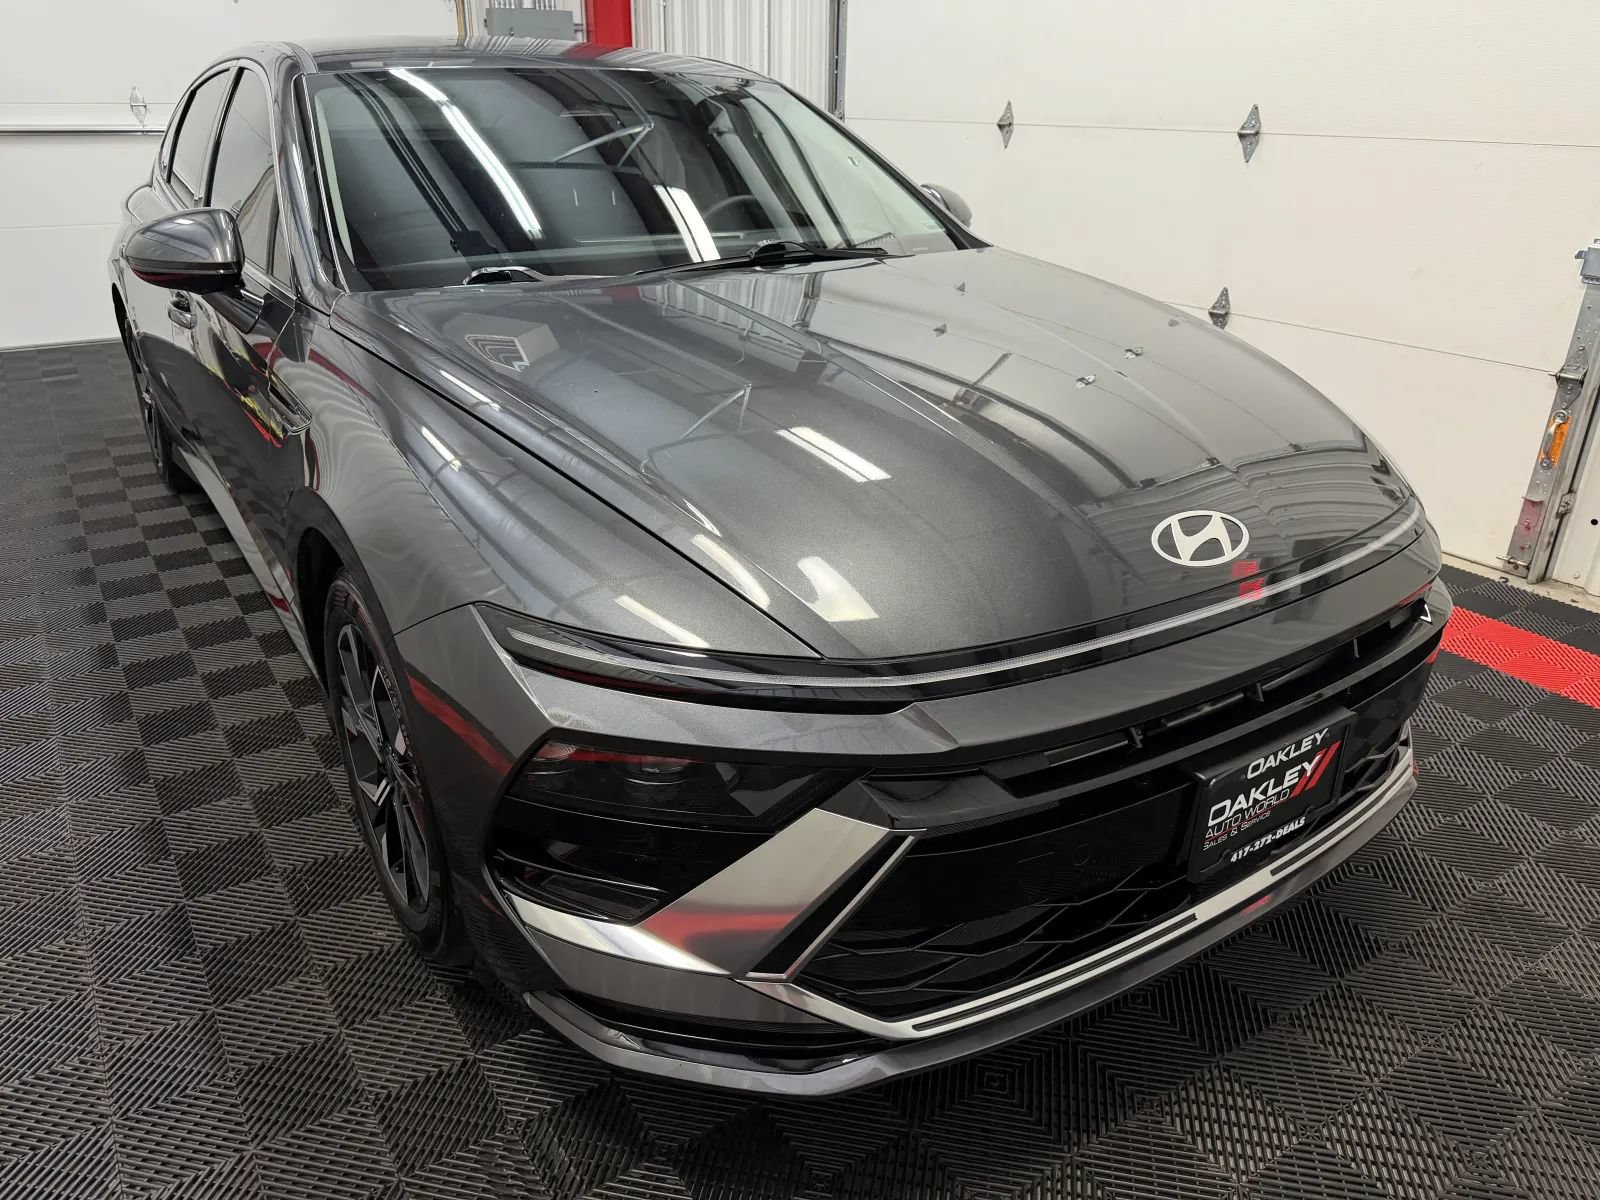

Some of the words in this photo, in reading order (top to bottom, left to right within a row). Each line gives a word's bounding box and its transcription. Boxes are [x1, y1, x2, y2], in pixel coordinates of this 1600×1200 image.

[1247, 728, 1328, 779] OAKLEY
[1205, 814, 1241, 838] AUTO
[1245, 789, 1290, 819] WORLD
[1208, 754, 1322, 827] OAKLEY
[1231, 816, 1306, 863] 417-272-DEALS
